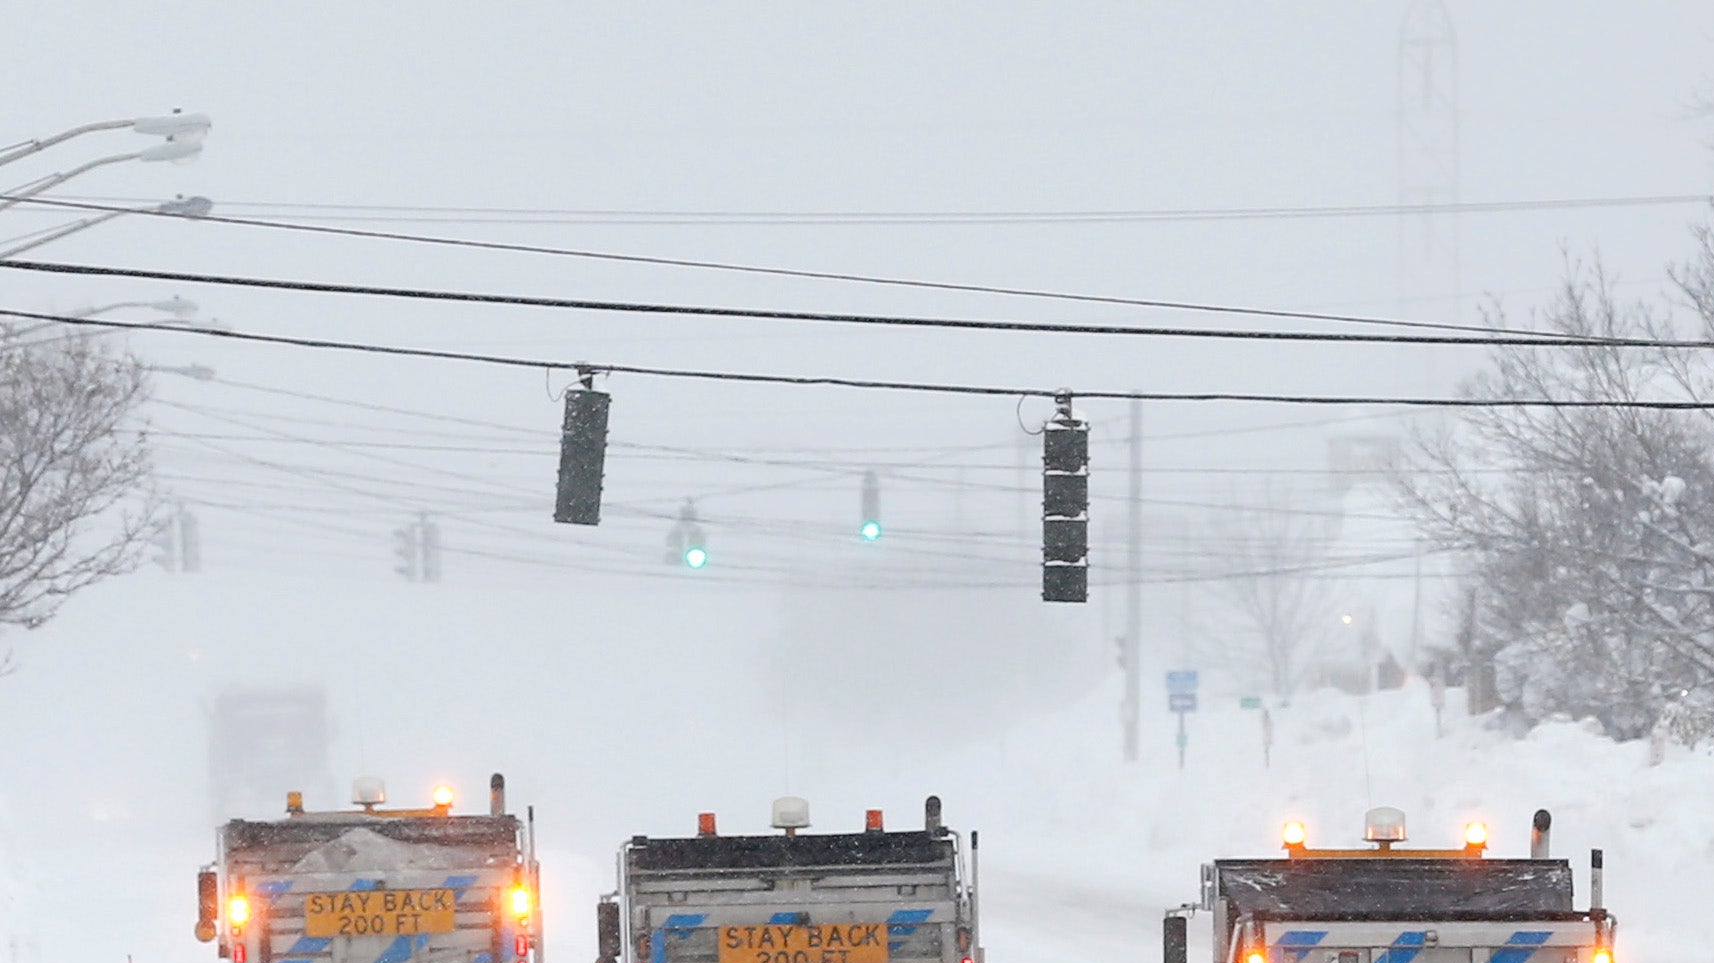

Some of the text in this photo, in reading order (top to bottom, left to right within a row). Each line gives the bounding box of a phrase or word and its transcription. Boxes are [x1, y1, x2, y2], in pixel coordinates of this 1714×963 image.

[310, 890, 448, 914] STAY BACK
[339, 913, 422, 935] 200 FT
[726, 924, 880, 949] STAY BACK
